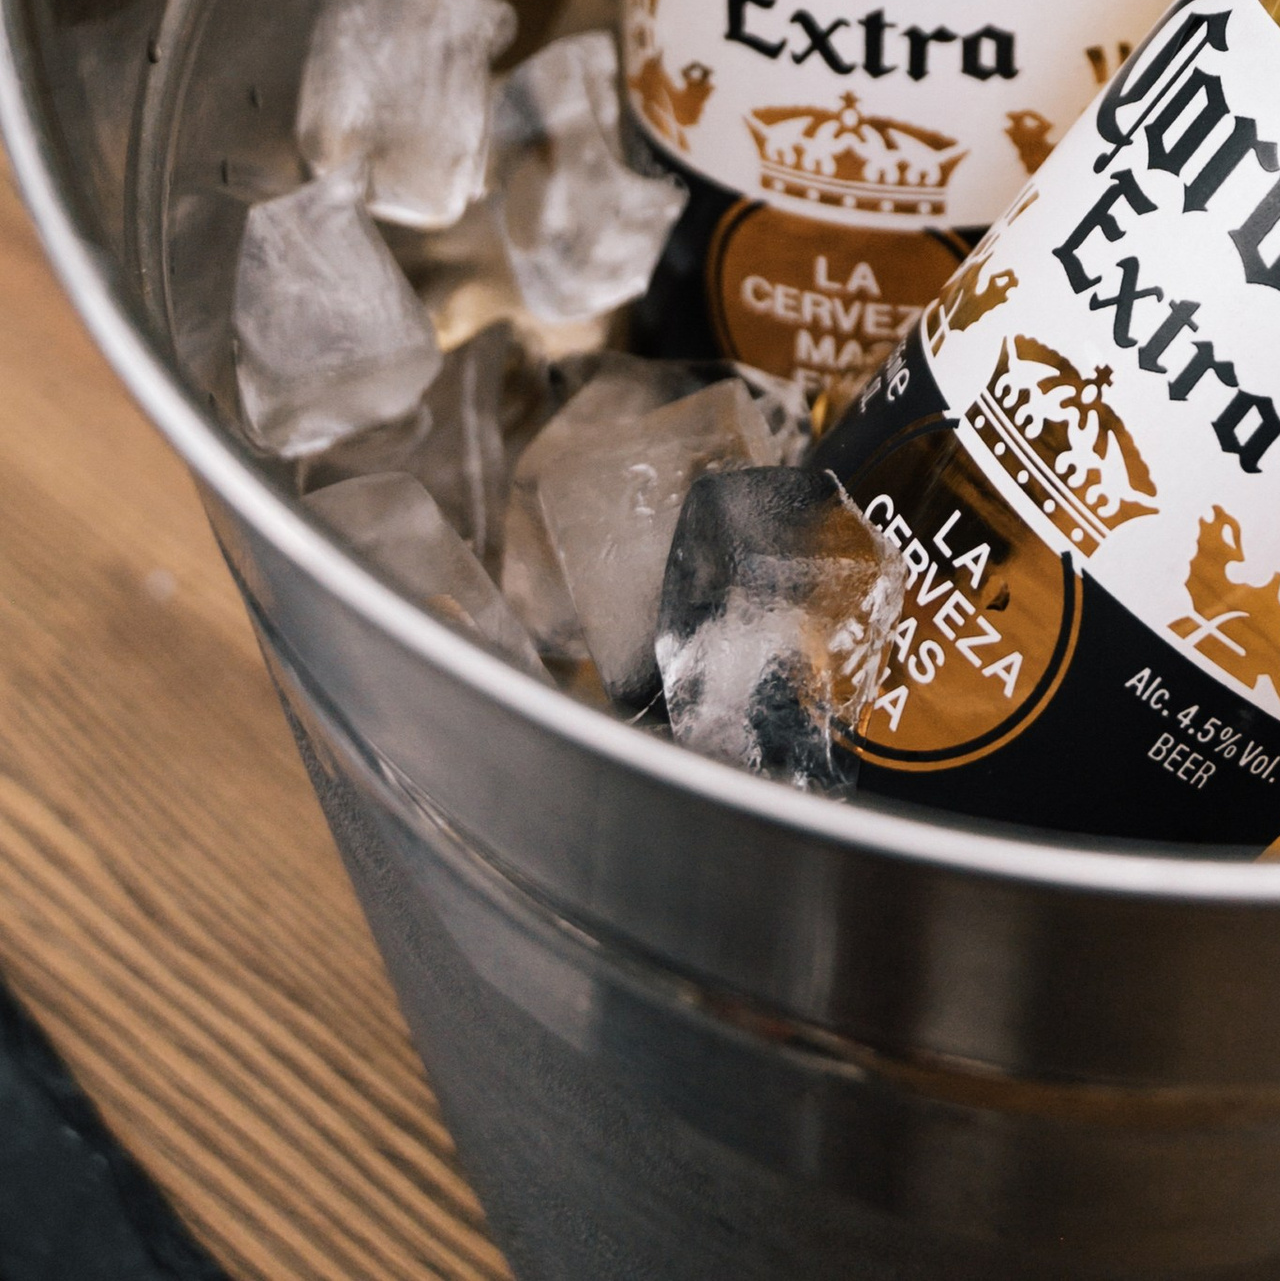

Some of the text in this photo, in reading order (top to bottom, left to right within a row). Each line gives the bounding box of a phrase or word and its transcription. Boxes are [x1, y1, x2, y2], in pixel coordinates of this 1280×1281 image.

[814, 255, 881, 296] LA
[740, 275, 925, 338] CERVEZ
[932, 509, 991, 589] LA
[862, 493, 1023, 699] CERVEZA
[1125, 667, 1170, 717] Alc.
[1147, 732, 1217, 789] BEER
